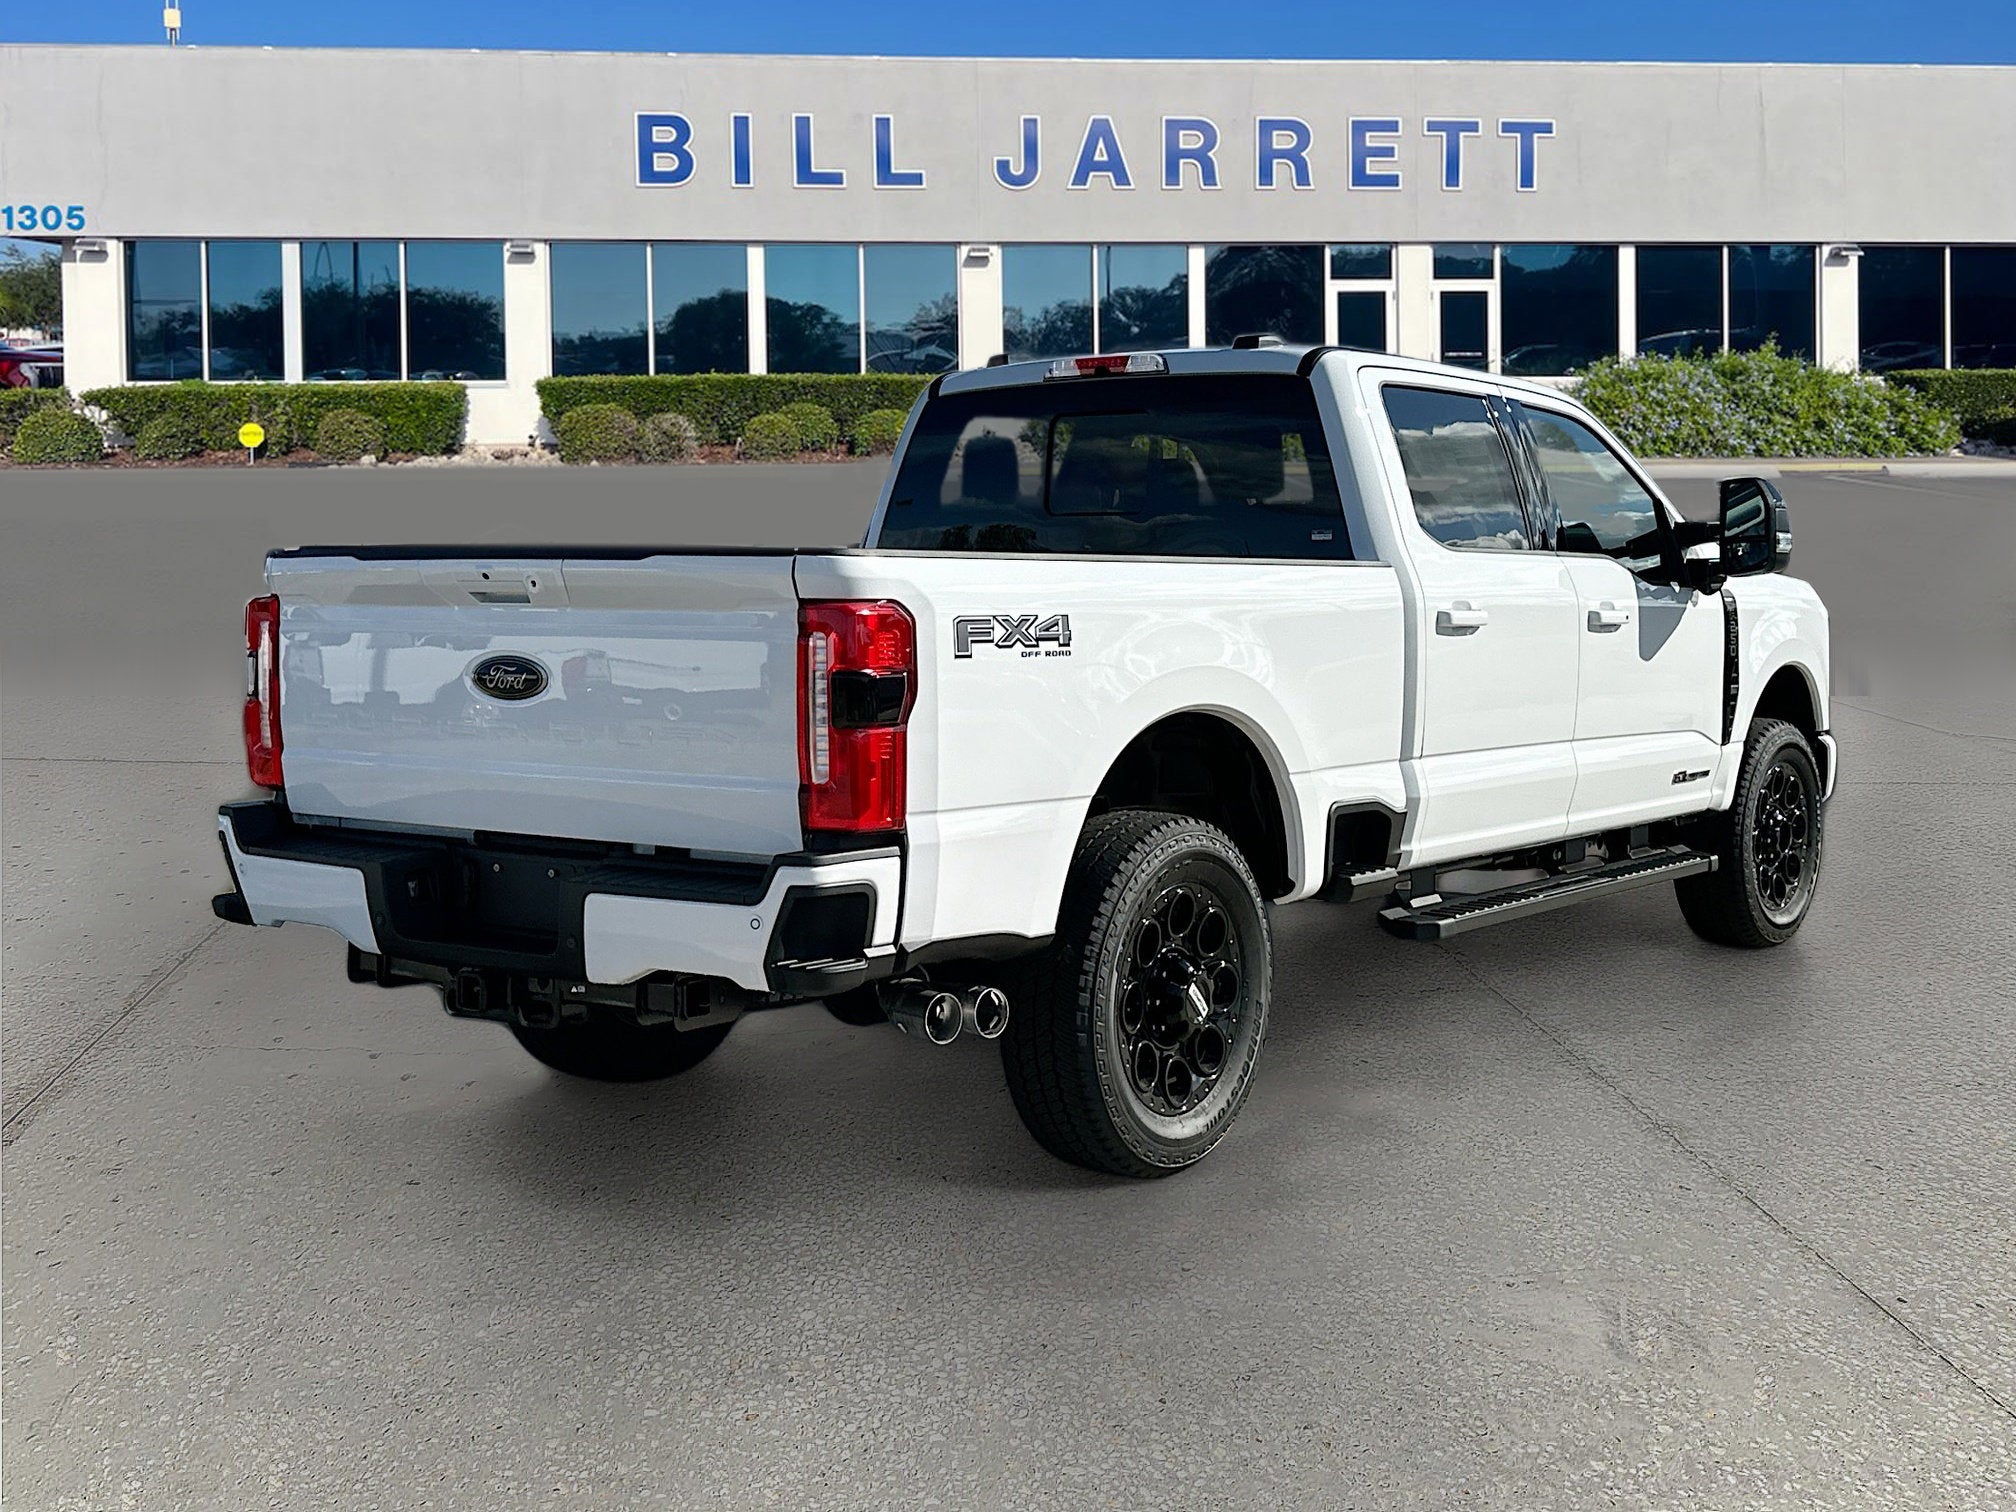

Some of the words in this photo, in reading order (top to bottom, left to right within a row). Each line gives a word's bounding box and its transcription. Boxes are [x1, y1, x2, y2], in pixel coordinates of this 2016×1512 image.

[635, 112, 925, 189] BILL
[994, 115, 1555, 192] JARRETT
[1, 205, 85, 231] 1305
[953, 614, 1071, 658] FX4
[482, 664, 527, 689] Ford
